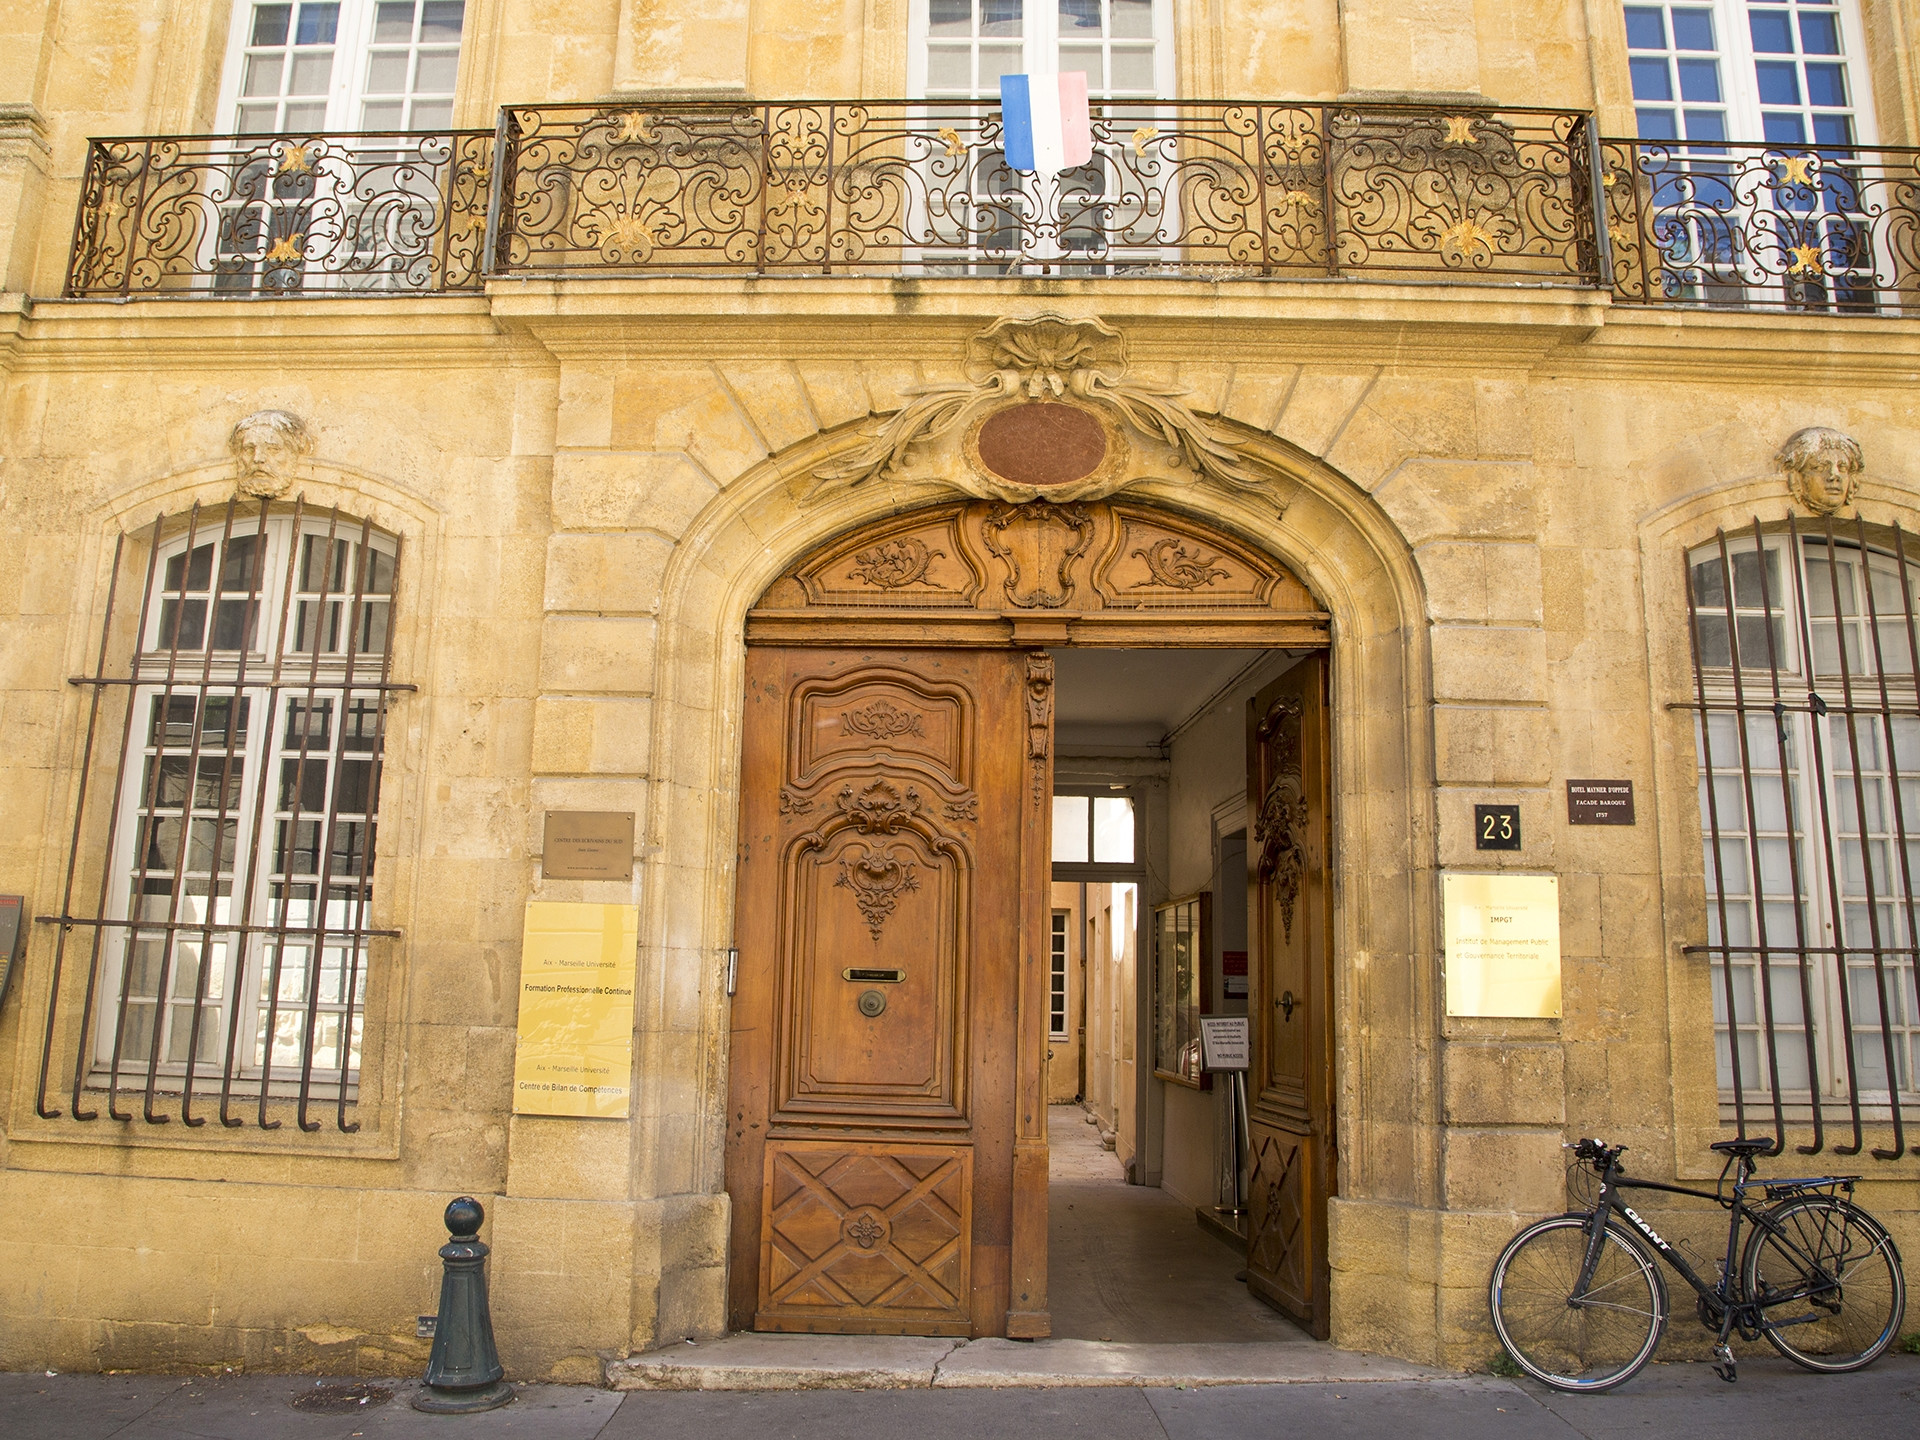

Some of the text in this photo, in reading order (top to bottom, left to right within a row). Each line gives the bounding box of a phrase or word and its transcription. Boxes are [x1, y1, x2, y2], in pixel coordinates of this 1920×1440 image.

[1483, 815, 1513, 839] 23
[1490, 939, 1529, 947] Management
[559, 960, 585, 968] Marseille
[586, 961, 617, 969] Université
[525, 984, 632, 996] Formation Professionnelle Continue
[552, 1065, 578, 1073] Marseille
[580, 1066, 610, 1074] Université
[520, 1082, 540, 1090] Centre
[542, 1083, 550, 1091] de
[569, 1084, 577, 1092] de
[1625, 1208, 1671, 1250] GIANT
